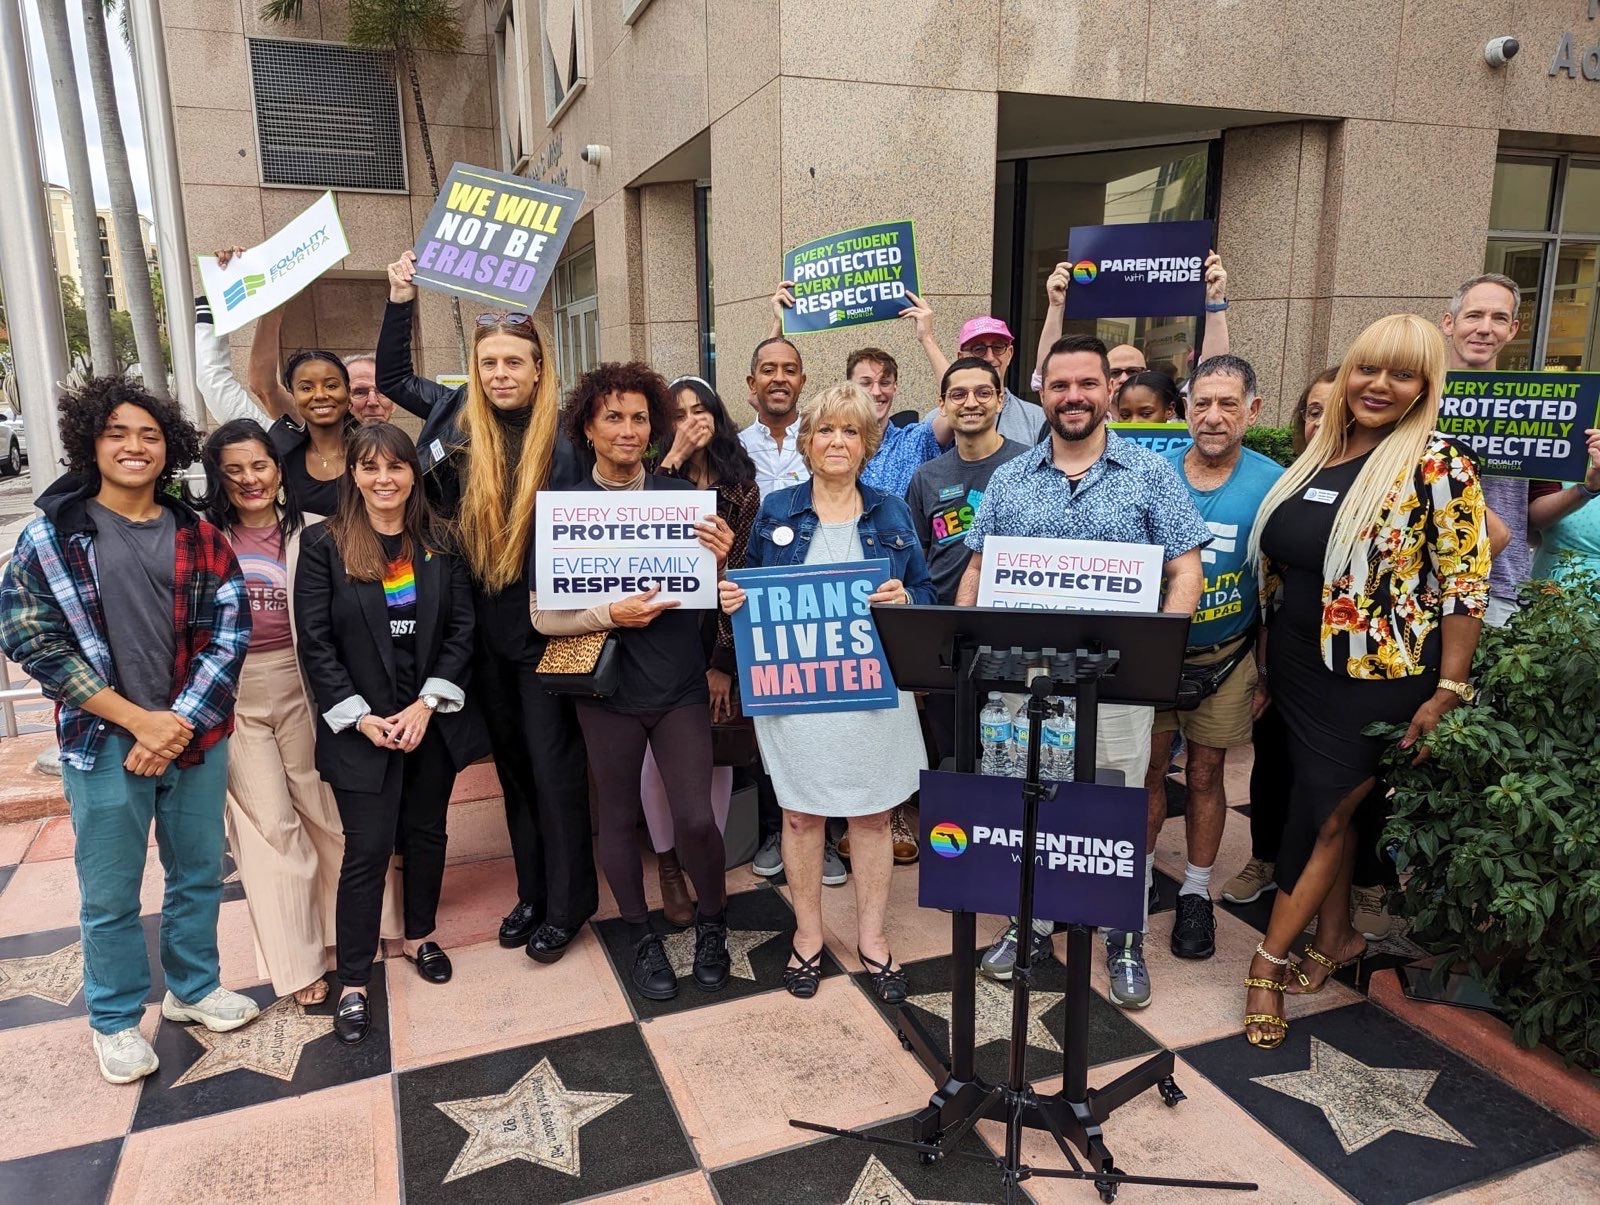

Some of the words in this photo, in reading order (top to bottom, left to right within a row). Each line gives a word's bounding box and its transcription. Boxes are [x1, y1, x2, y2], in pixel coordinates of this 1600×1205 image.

[446, 182, 495, 216] WE
[494, 193, 562, 234] WILL
[435, 212, 502, 250] NOT
[503, 229, 548, 263] BE
[794, 244, 833, 266] EVERY
[837, 232, 899, 253] STUDENT
[269, 225, 326, 276] EQUALITY
[271, 235, 330, 283] FLORIDA
[417, 241, 536, 293] ERASED
[794, 247, 902, 282] PROTECTED
[1100, 257, 1202, 272] PARENTING
[1125, 274, 1145, 282] with
[1147, 269, 1201, 283] PRIDE
[794, 276, 841, 297] EVERY
[845, 266, 902, 287] FAMILY
[795, 281, 905, 315] RESPECTED
[847, 306, 874, 316] EQUALITY
[1443, 381, 1489, 395] VERY
[1493, 382, 1581, 398] STUDENT
[1438, 418, 1489, 433] VERY
[1494, 420, 1574, 437] FAMILY
[1487, 459, 1523, 467] EQUALITY
[552, 507, 611, 522] EVERY
[616, 506, 699, 521] STUDENT
[932, 506, 974, 539] RES
[552, 523, 699, 541] PROTECTED
[552, 557, 621, 575] EVERY
[628, 556, 700, 574] FAMILY
[996, 552, 1053, 569] EVERY
[1057, 555, 1145, 576] STUDENT
[247, 587, 287, 600] TEC
[553, 576, 700, 593] RESPECTED
[995, 569, 1143, 594] PROTECTED
[1203, 571, 1243, 592] LITY
[744, 579, 874, 623] TRANS
[1213, 603, 1238, 617] PAC
[390, 620, 416, 635] SIST.
[751, 619, 874, 662] LIVES
[750, 658, 882, 697] MATTER
[1048, 852, 1134, 878] PRIDE
